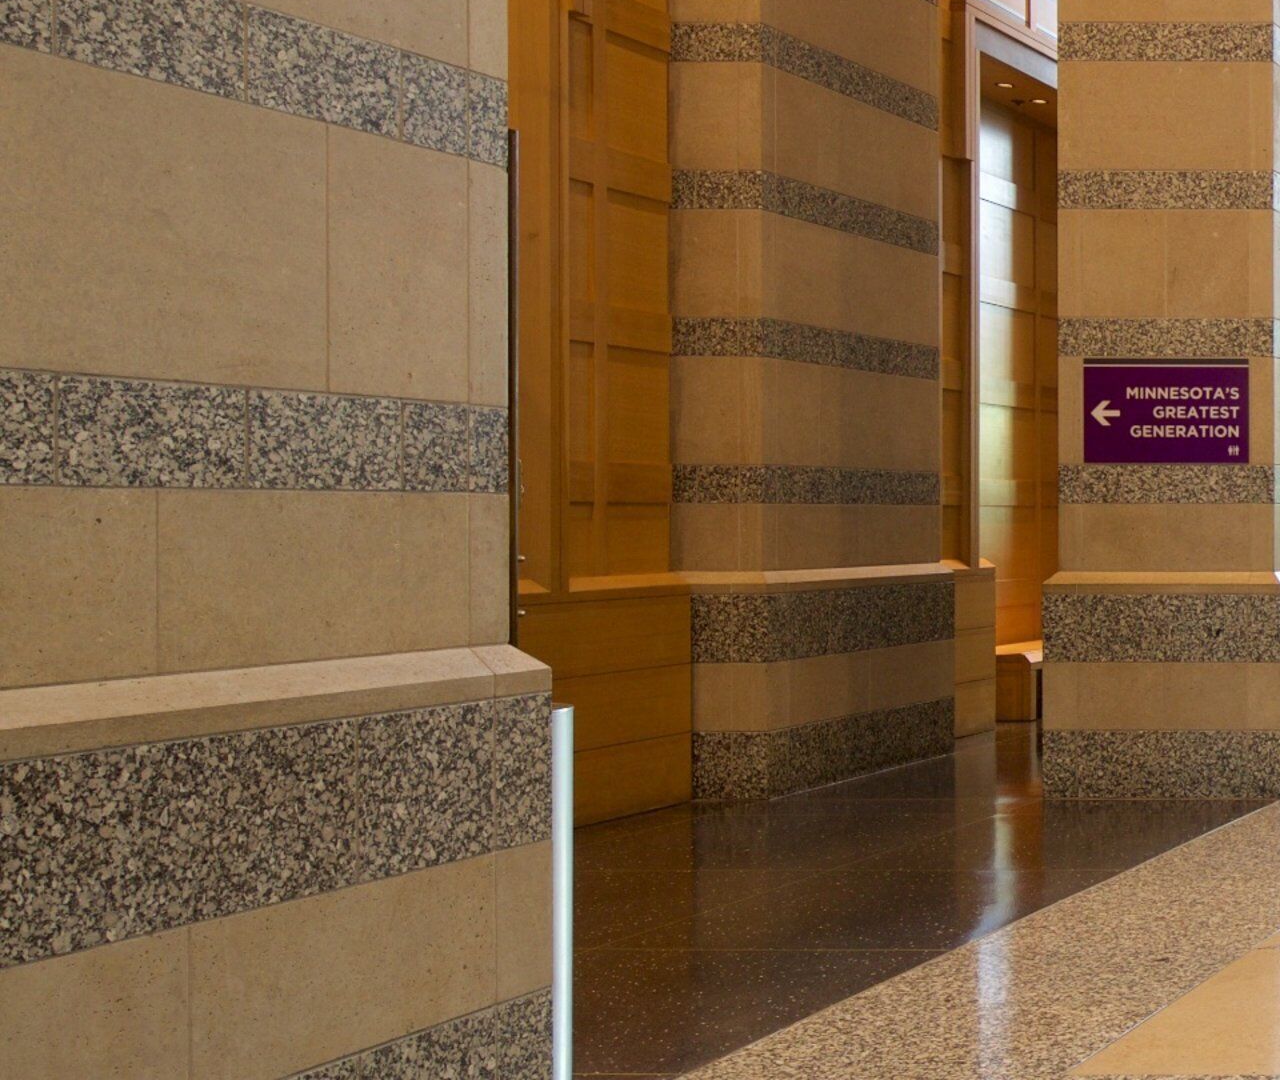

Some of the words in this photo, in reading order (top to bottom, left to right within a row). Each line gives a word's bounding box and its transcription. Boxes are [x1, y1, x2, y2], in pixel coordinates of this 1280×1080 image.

[1126, 386, 1240, 400] MINNESOTA'S
[1152, 406, 1240, 419] GREATEST
[1130, 425, 1240, 438] GENERATION
